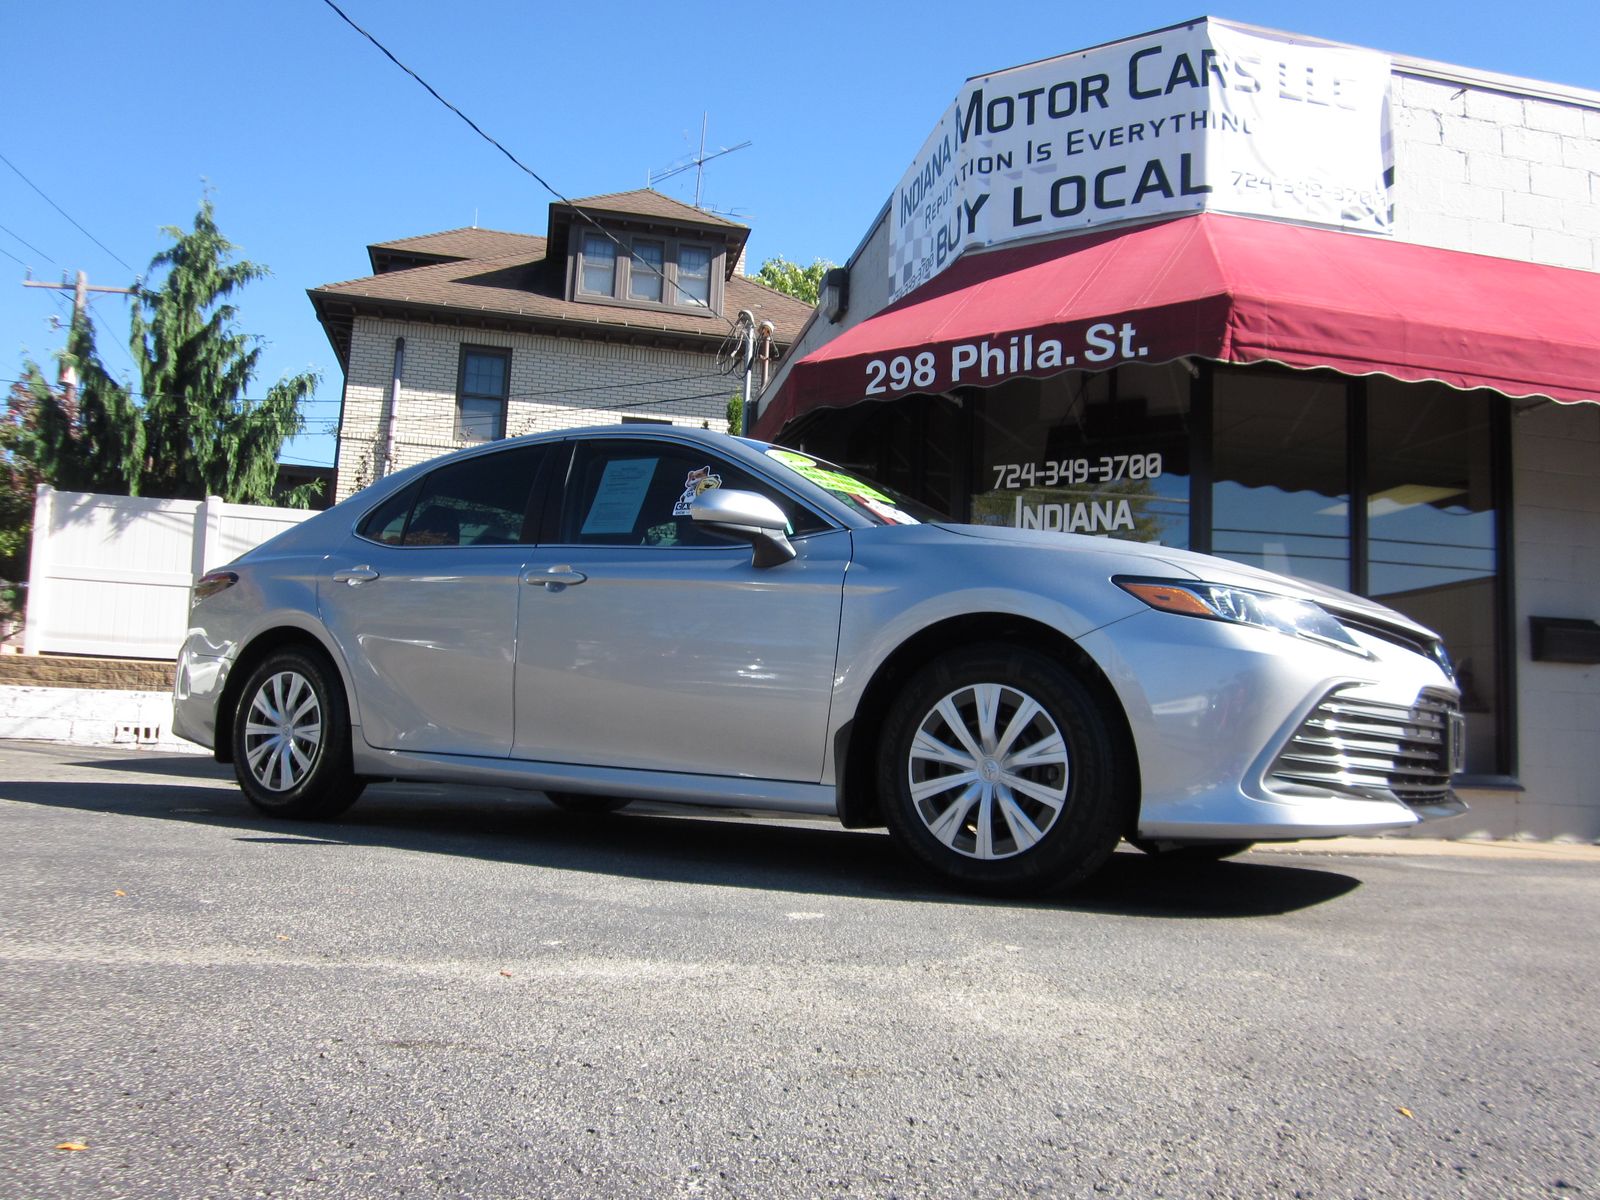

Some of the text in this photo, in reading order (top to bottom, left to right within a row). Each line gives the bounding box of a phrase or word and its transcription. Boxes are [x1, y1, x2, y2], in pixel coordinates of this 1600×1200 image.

[901, 133, 951, 229] INDIANA
[954, 73, 1109, 153] MOTOR
[1129, 45, 1261, 101] CARS
[1027, 140, 1052, 165] IS
[937, 152, 1213, 269] BUY LOCAL
[865, 323, 1148, 396] 298 Phila. St.
[993, 453, 1162, 489] 724-349-3700
[1015, 496, 1136, 533] INDIANA
